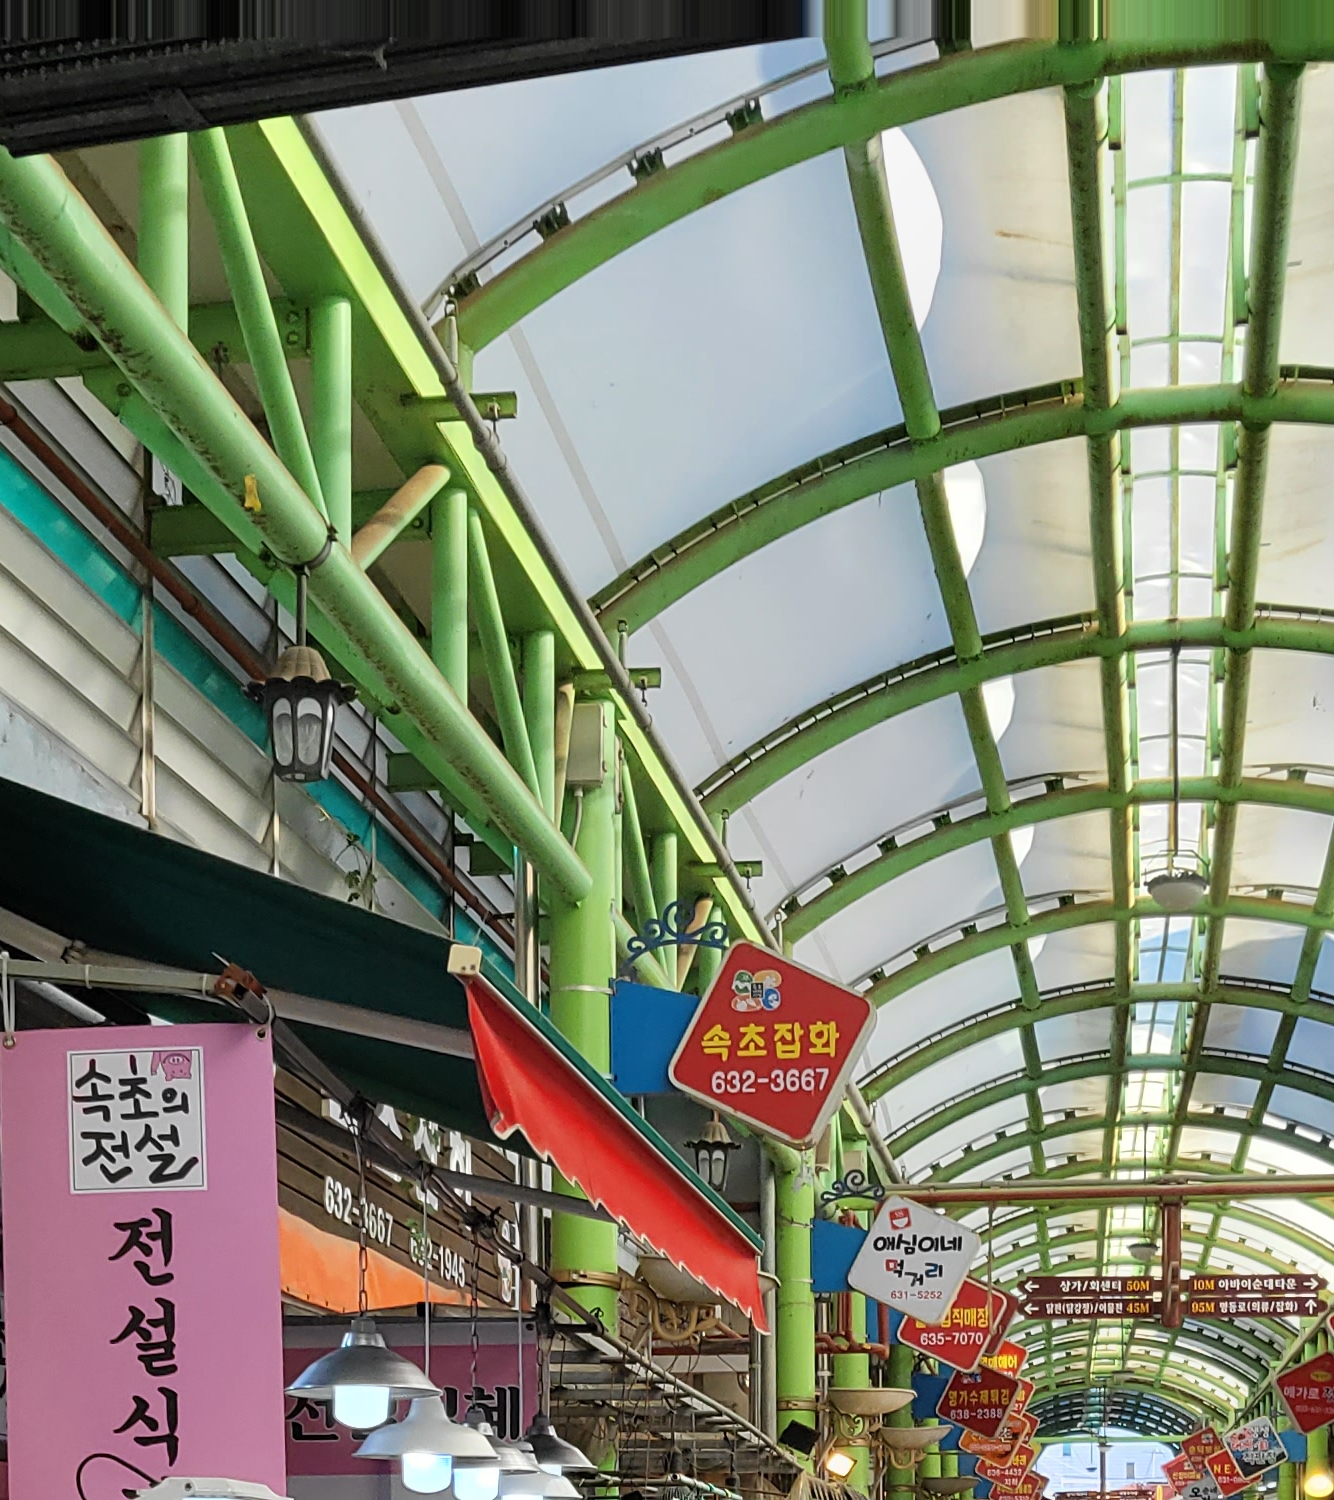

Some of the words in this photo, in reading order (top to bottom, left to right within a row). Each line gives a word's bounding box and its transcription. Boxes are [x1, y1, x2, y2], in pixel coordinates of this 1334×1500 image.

[701, 1019, 840, 1061] 속초잡화
[72, 1054, 191, 1124] 속초의
[710, 1066, 829, 1094] 632-3667
[81, 1123, 200, 1184] 전설
[873, 1233, 963, 1256] 애심이네
[885, 1258, 944, 1288] 먹거리
[1059, 1280, 1123, 1293] 상가/회센터
[1126, 1280, 1151, 1292] 50M
[1192, 1279, 1215, 1291] 10M
[1218, 1278, 1298, 1292] 아바이순대타운
[890, 1290, 944, 1300] 631-5252
[1126, 1302, 1151, 1314] 45M
[1191, 1302, 1215, 1313] 95M
[919, 1331, 984, 1346] 635-7070
